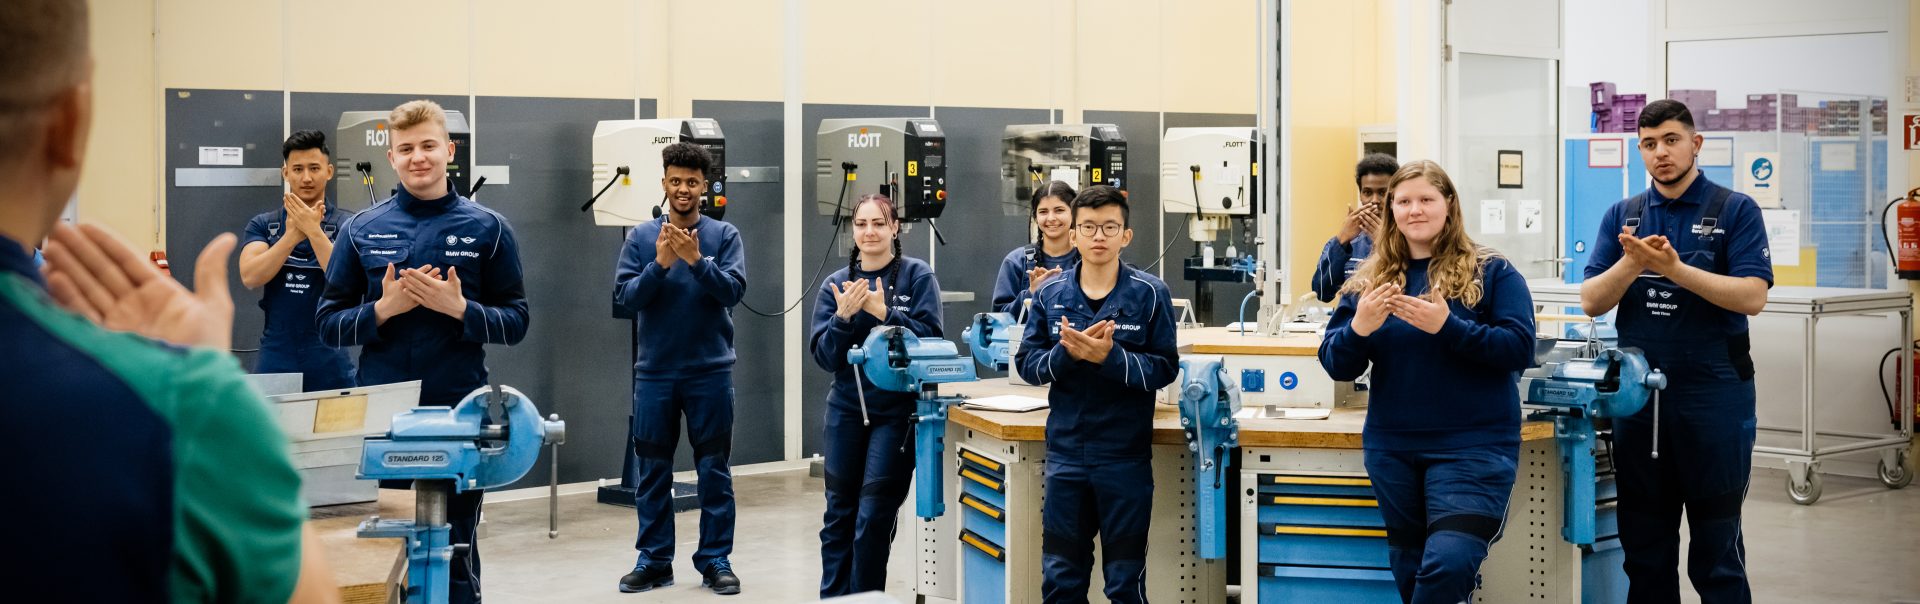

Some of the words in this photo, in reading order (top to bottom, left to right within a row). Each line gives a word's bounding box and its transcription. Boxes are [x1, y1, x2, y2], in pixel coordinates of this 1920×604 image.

[366, 129, 389, 147] FLOT
[910, 163, 915, 174] 3
[1094, 171, 1099, 180] 2
[388, 455, 430, 463] STANDARD
